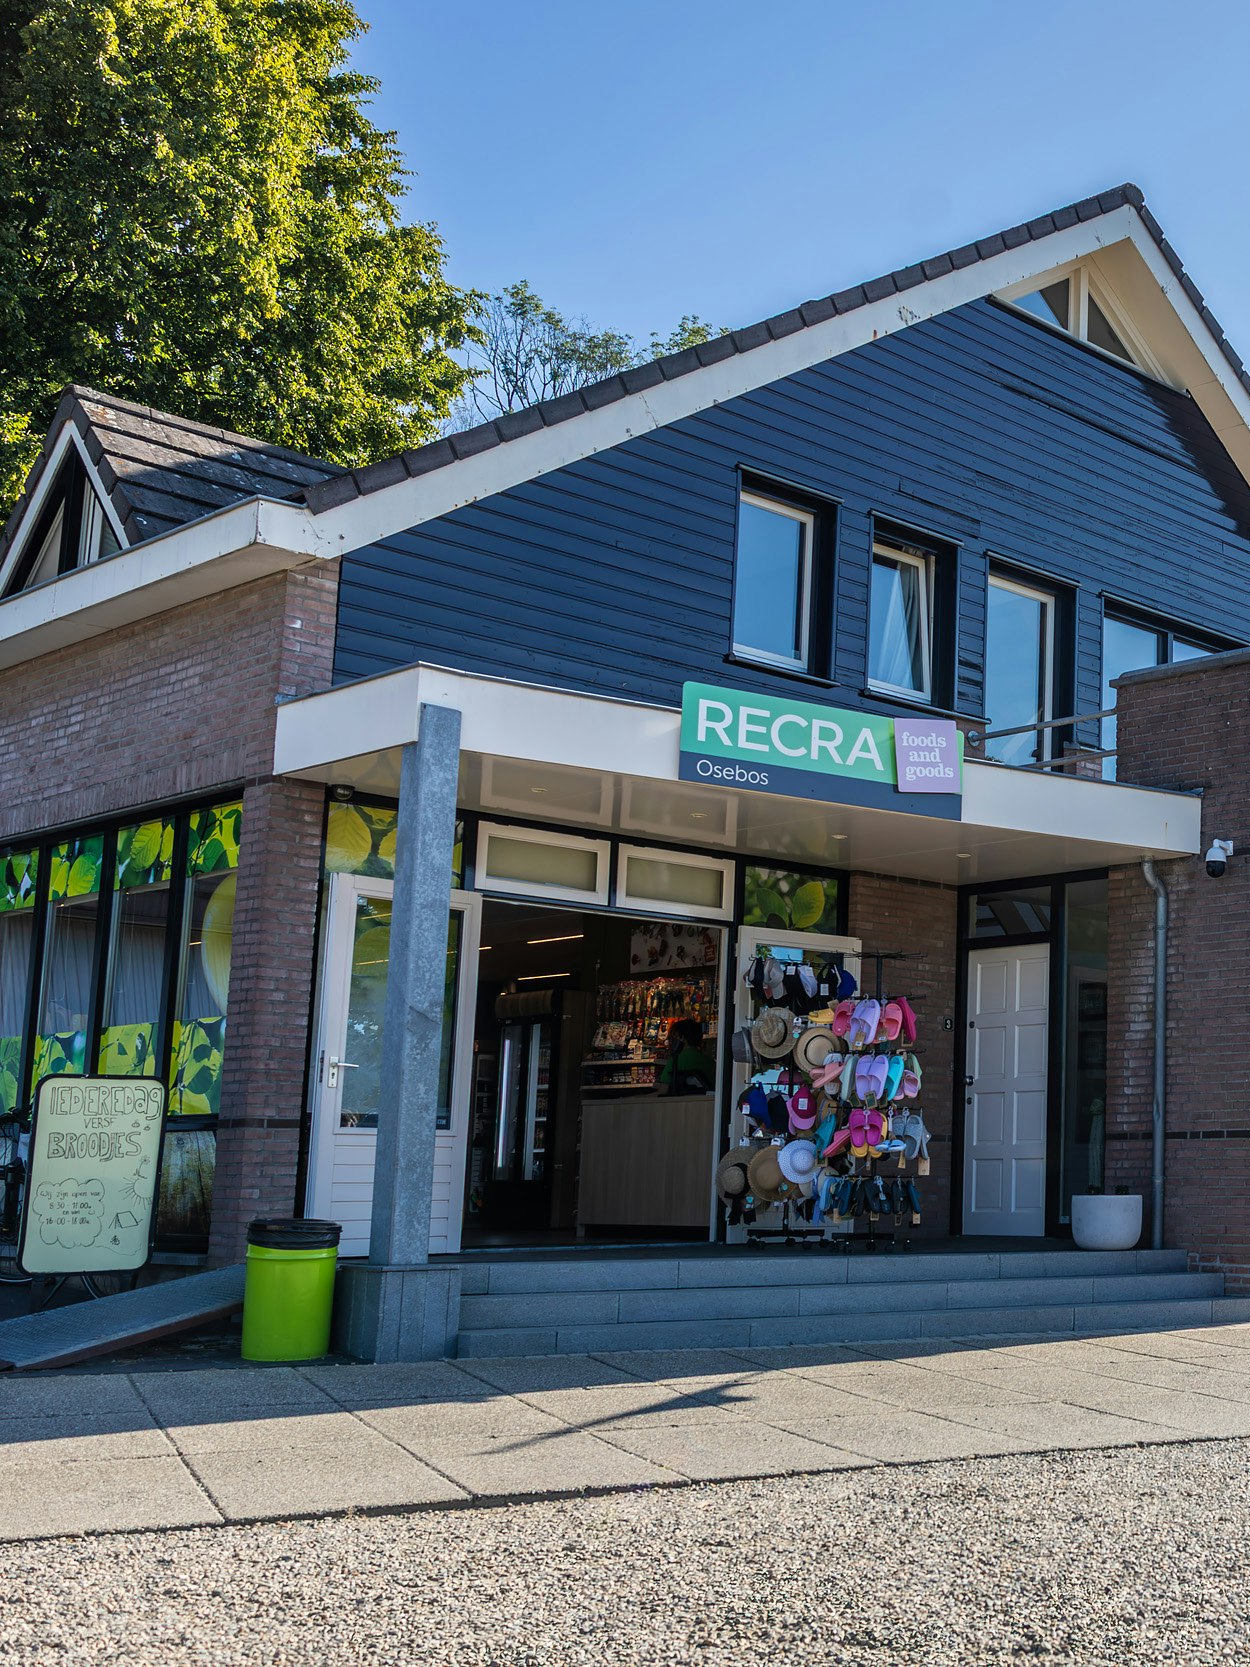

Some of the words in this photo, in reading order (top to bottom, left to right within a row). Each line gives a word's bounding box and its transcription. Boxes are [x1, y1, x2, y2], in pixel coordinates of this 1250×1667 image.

[697, 698, 884, 771] RECRA
[901, 731, 946, 748] foods
[909, 748, 941, 763] and
[696, 759, 769, 785] Osebos
[905, 763, 954, 781] goods
[946, 1019, 951, 1029] 3
[48, 1131, 142, 1162] BROODJES
